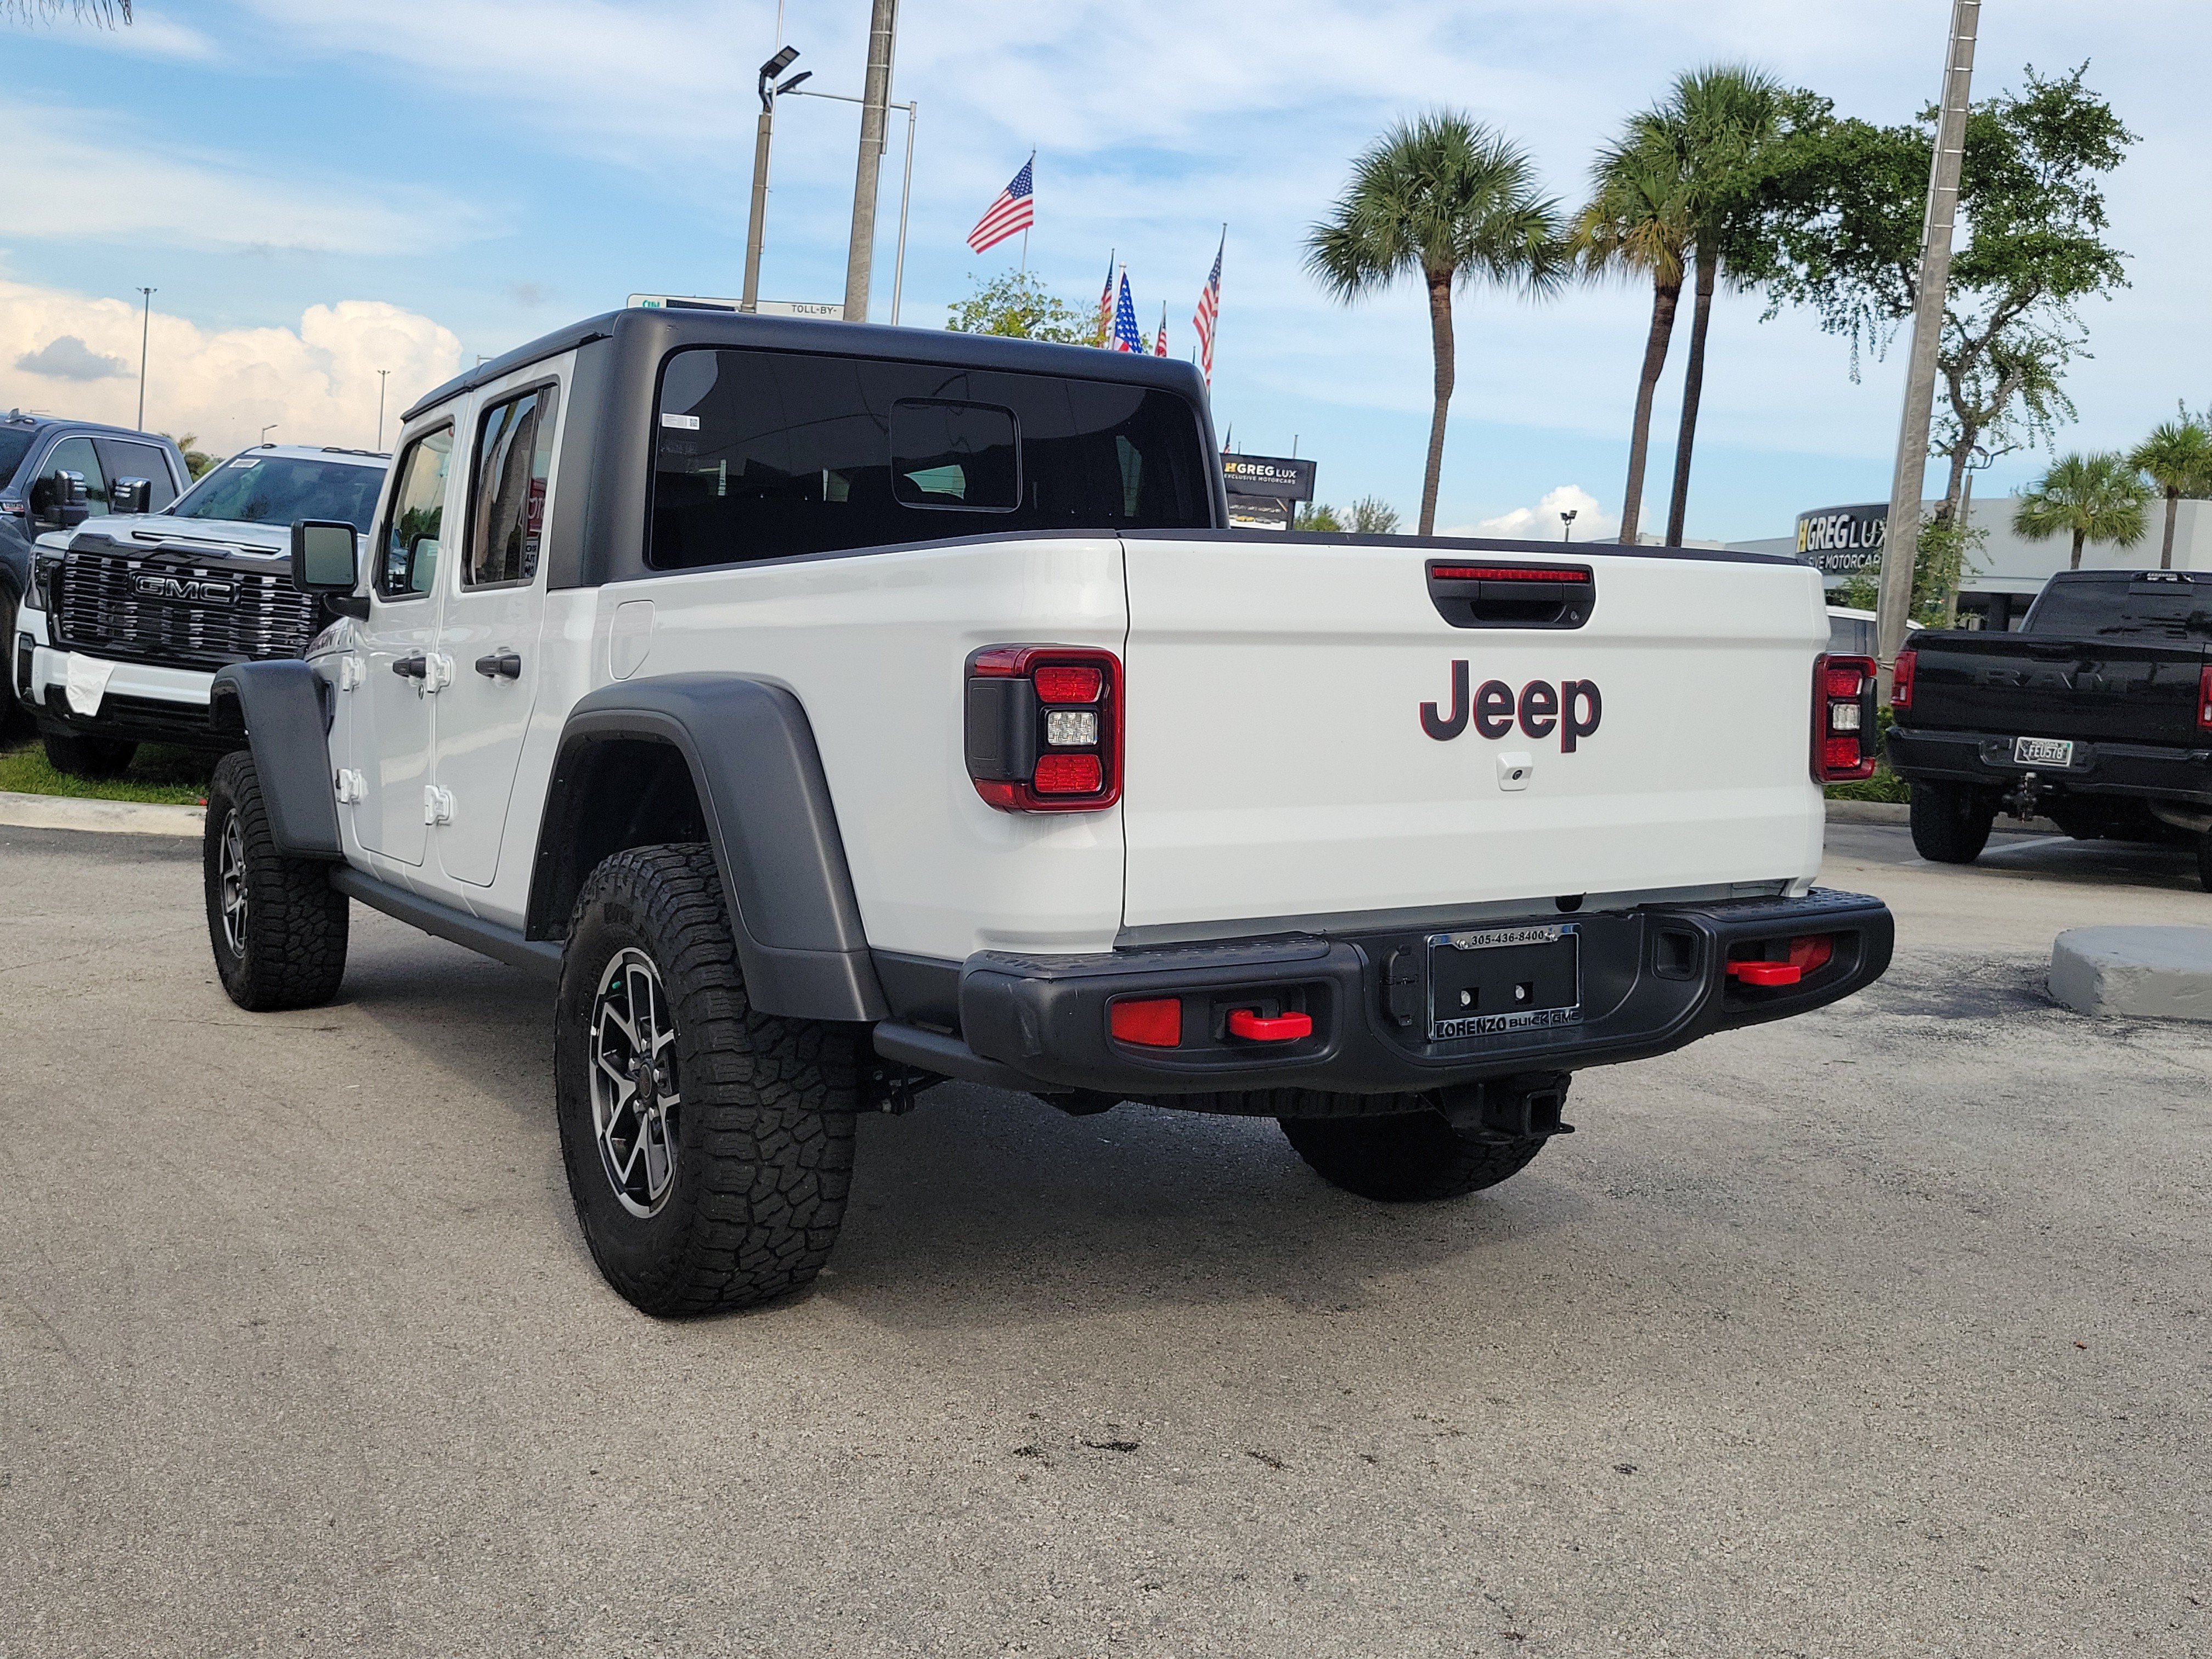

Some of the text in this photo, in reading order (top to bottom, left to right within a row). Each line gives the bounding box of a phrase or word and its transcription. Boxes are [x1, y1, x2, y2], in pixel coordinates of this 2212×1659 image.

[1257, 476, 1296, 485] MOTORCARS
[1276, 469, 1297, 478] LUX
[1825, 553, 1882, 569] MOTORCAR
[136, 575, 231, 603] GMC
[1419, 659, 1602, 753] Jeep
[1471, 930, 1544, 946] 305-436-8400
[1435, 1016, 1507, 1039] LORENZO
[1509, 1014, 1549, 1029] BUICK
